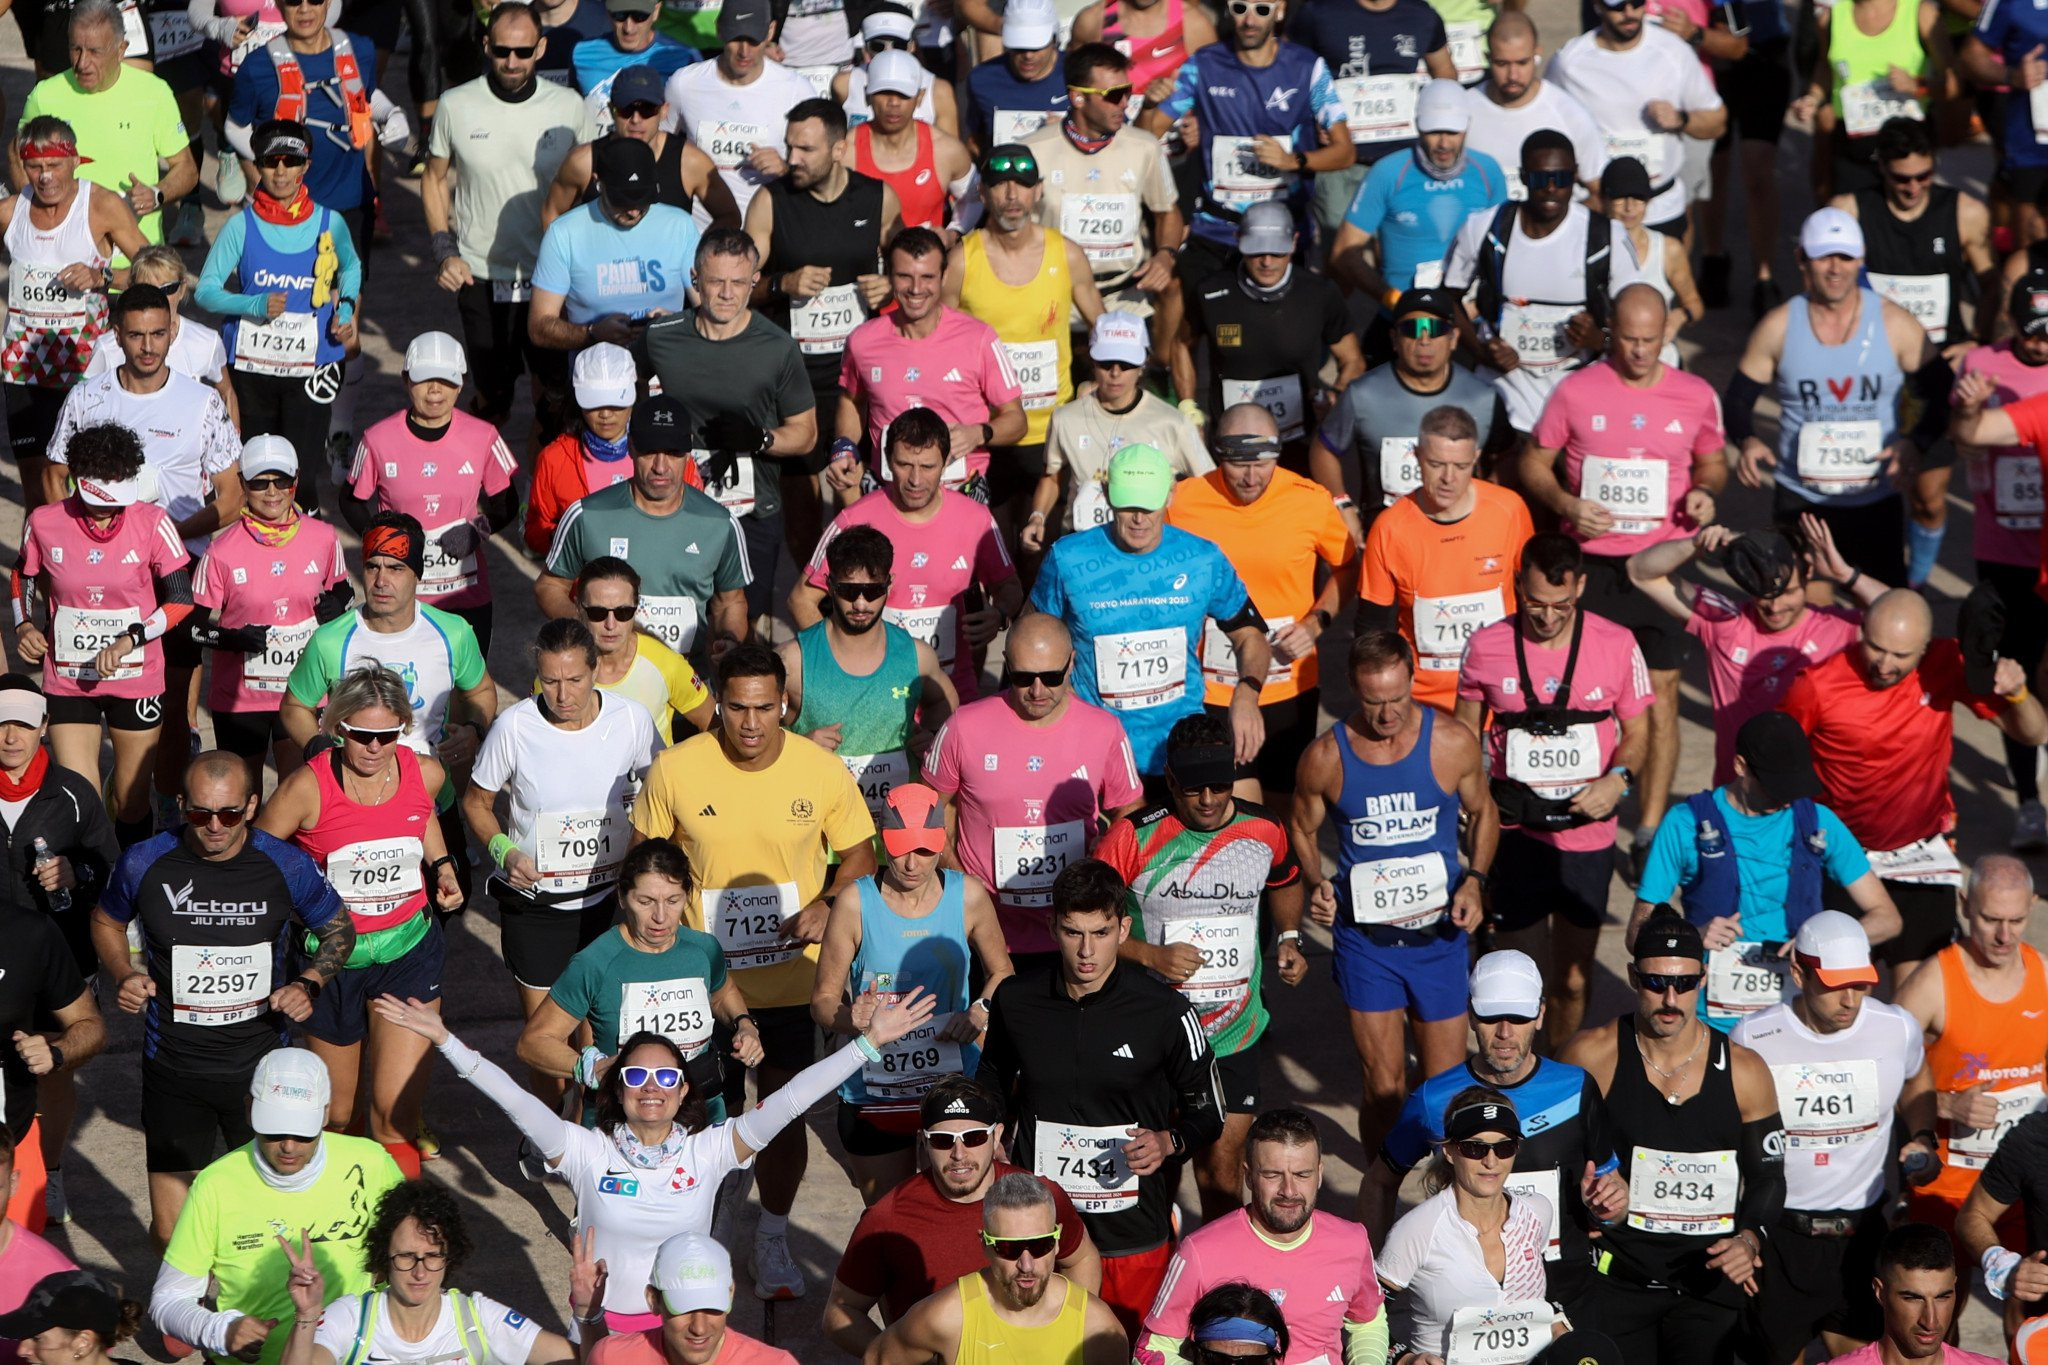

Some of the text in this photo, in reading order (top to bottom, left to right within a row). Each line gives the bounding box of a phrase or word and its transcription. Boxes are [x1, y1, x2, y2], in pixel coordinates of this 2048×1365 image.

[1078, 219, 1124, 234] 7260
[22, 286, 67, 303] 8699
[808, 308, 853, 328] 7570
[250, 332, 307, 352] 17374
[1015, 367, 1041, 383] 08
[1817, 446, 1865, 465] 7350
[1599, 484, 1649, 504] 8836
[1089, 600, 1117, 609] TOKYO
[1119, 597, 1166, 607] MARATHON
[1117, 657, 1169, 679] 7179
[1528, 749, 1581, 768] 8500
[1365, 792, 1417, 817] BRYN
[1386, 814, 1433, 832] PLAN
[558, 835, 611, 859] 7091
[349, 864, 401, 885] 7092
[1017, 852, 1067, 876] 8231
[1374, 883, 1429, 909] 8735
[190, 917, 256, 926] JIU JITSU
[725, 914, 780, 937] 7123
[187, 973, 259, 994] 22597
[636, 1009, 703, 1034] 11253
[883, 1047, 940, 1073] 8769
[1794, 1094, 1854, 1117] 7461
[1057, 1156, 1116, 1178] 7434
[602, 1179, 635, 1194] CIC
[1654, 1181, 1715, 1202] 8434
[1473, 1327, 1530, 1351] 7093
